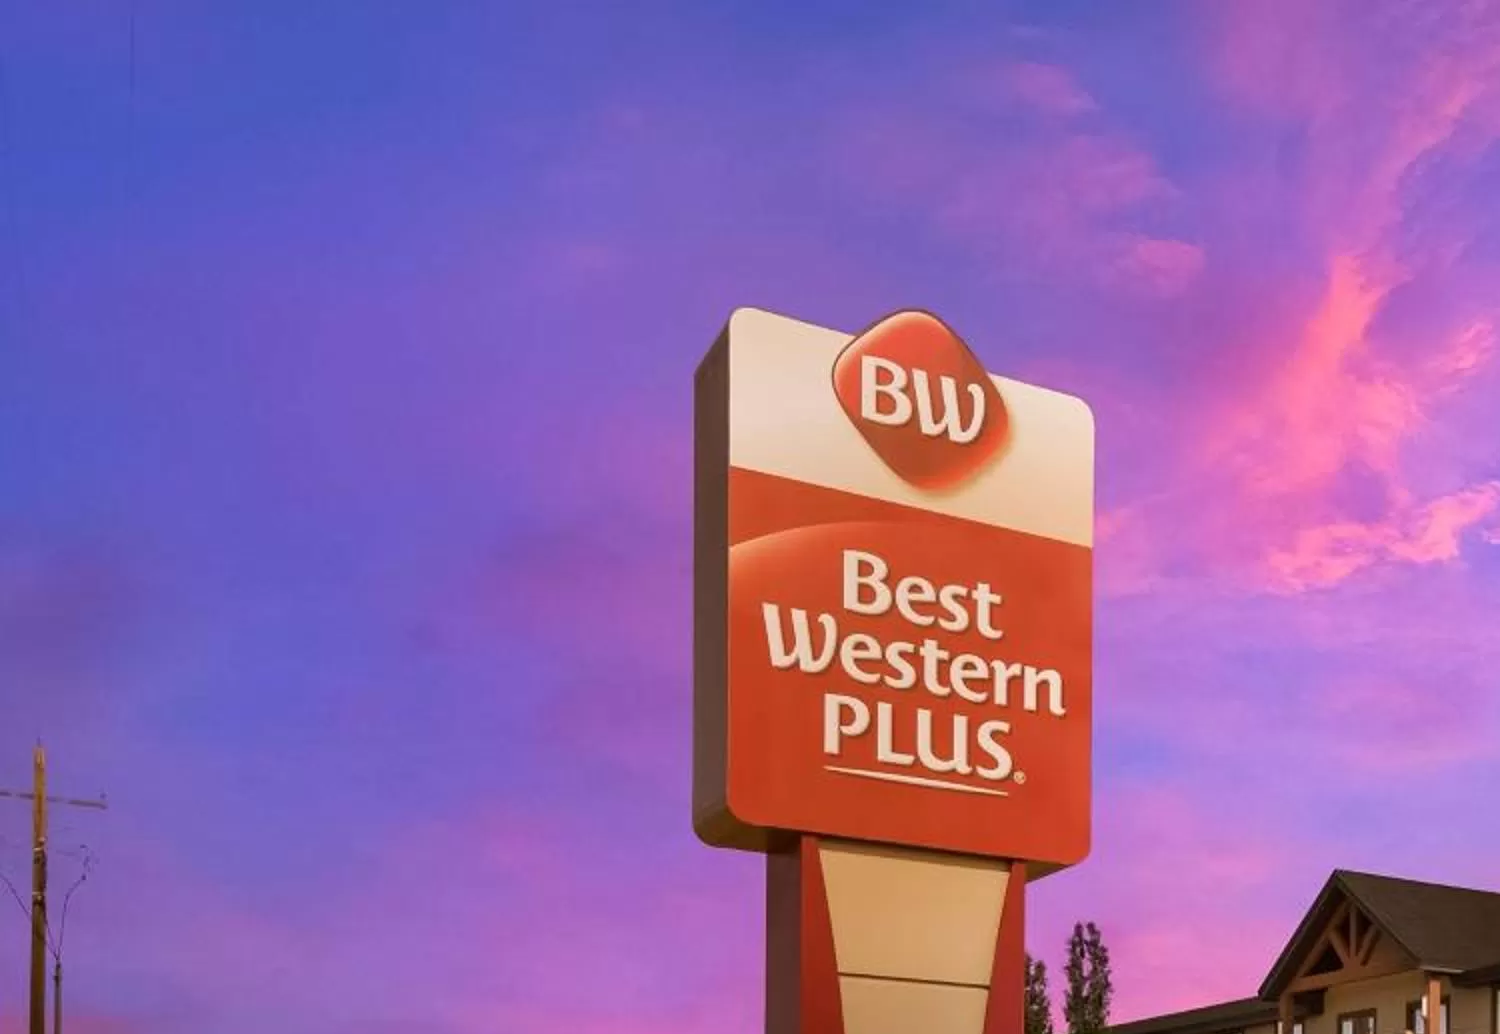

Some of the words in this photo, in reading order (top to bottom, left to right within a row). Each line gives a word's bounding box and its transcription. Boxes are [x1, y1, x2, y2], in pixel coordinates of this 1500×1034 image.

[861, 355, 985, 443] BW
[843, 549, 1003, 638] Best
[762, 602, 1066, 715] Western
[823, 693, 1013, 779] PLUS
